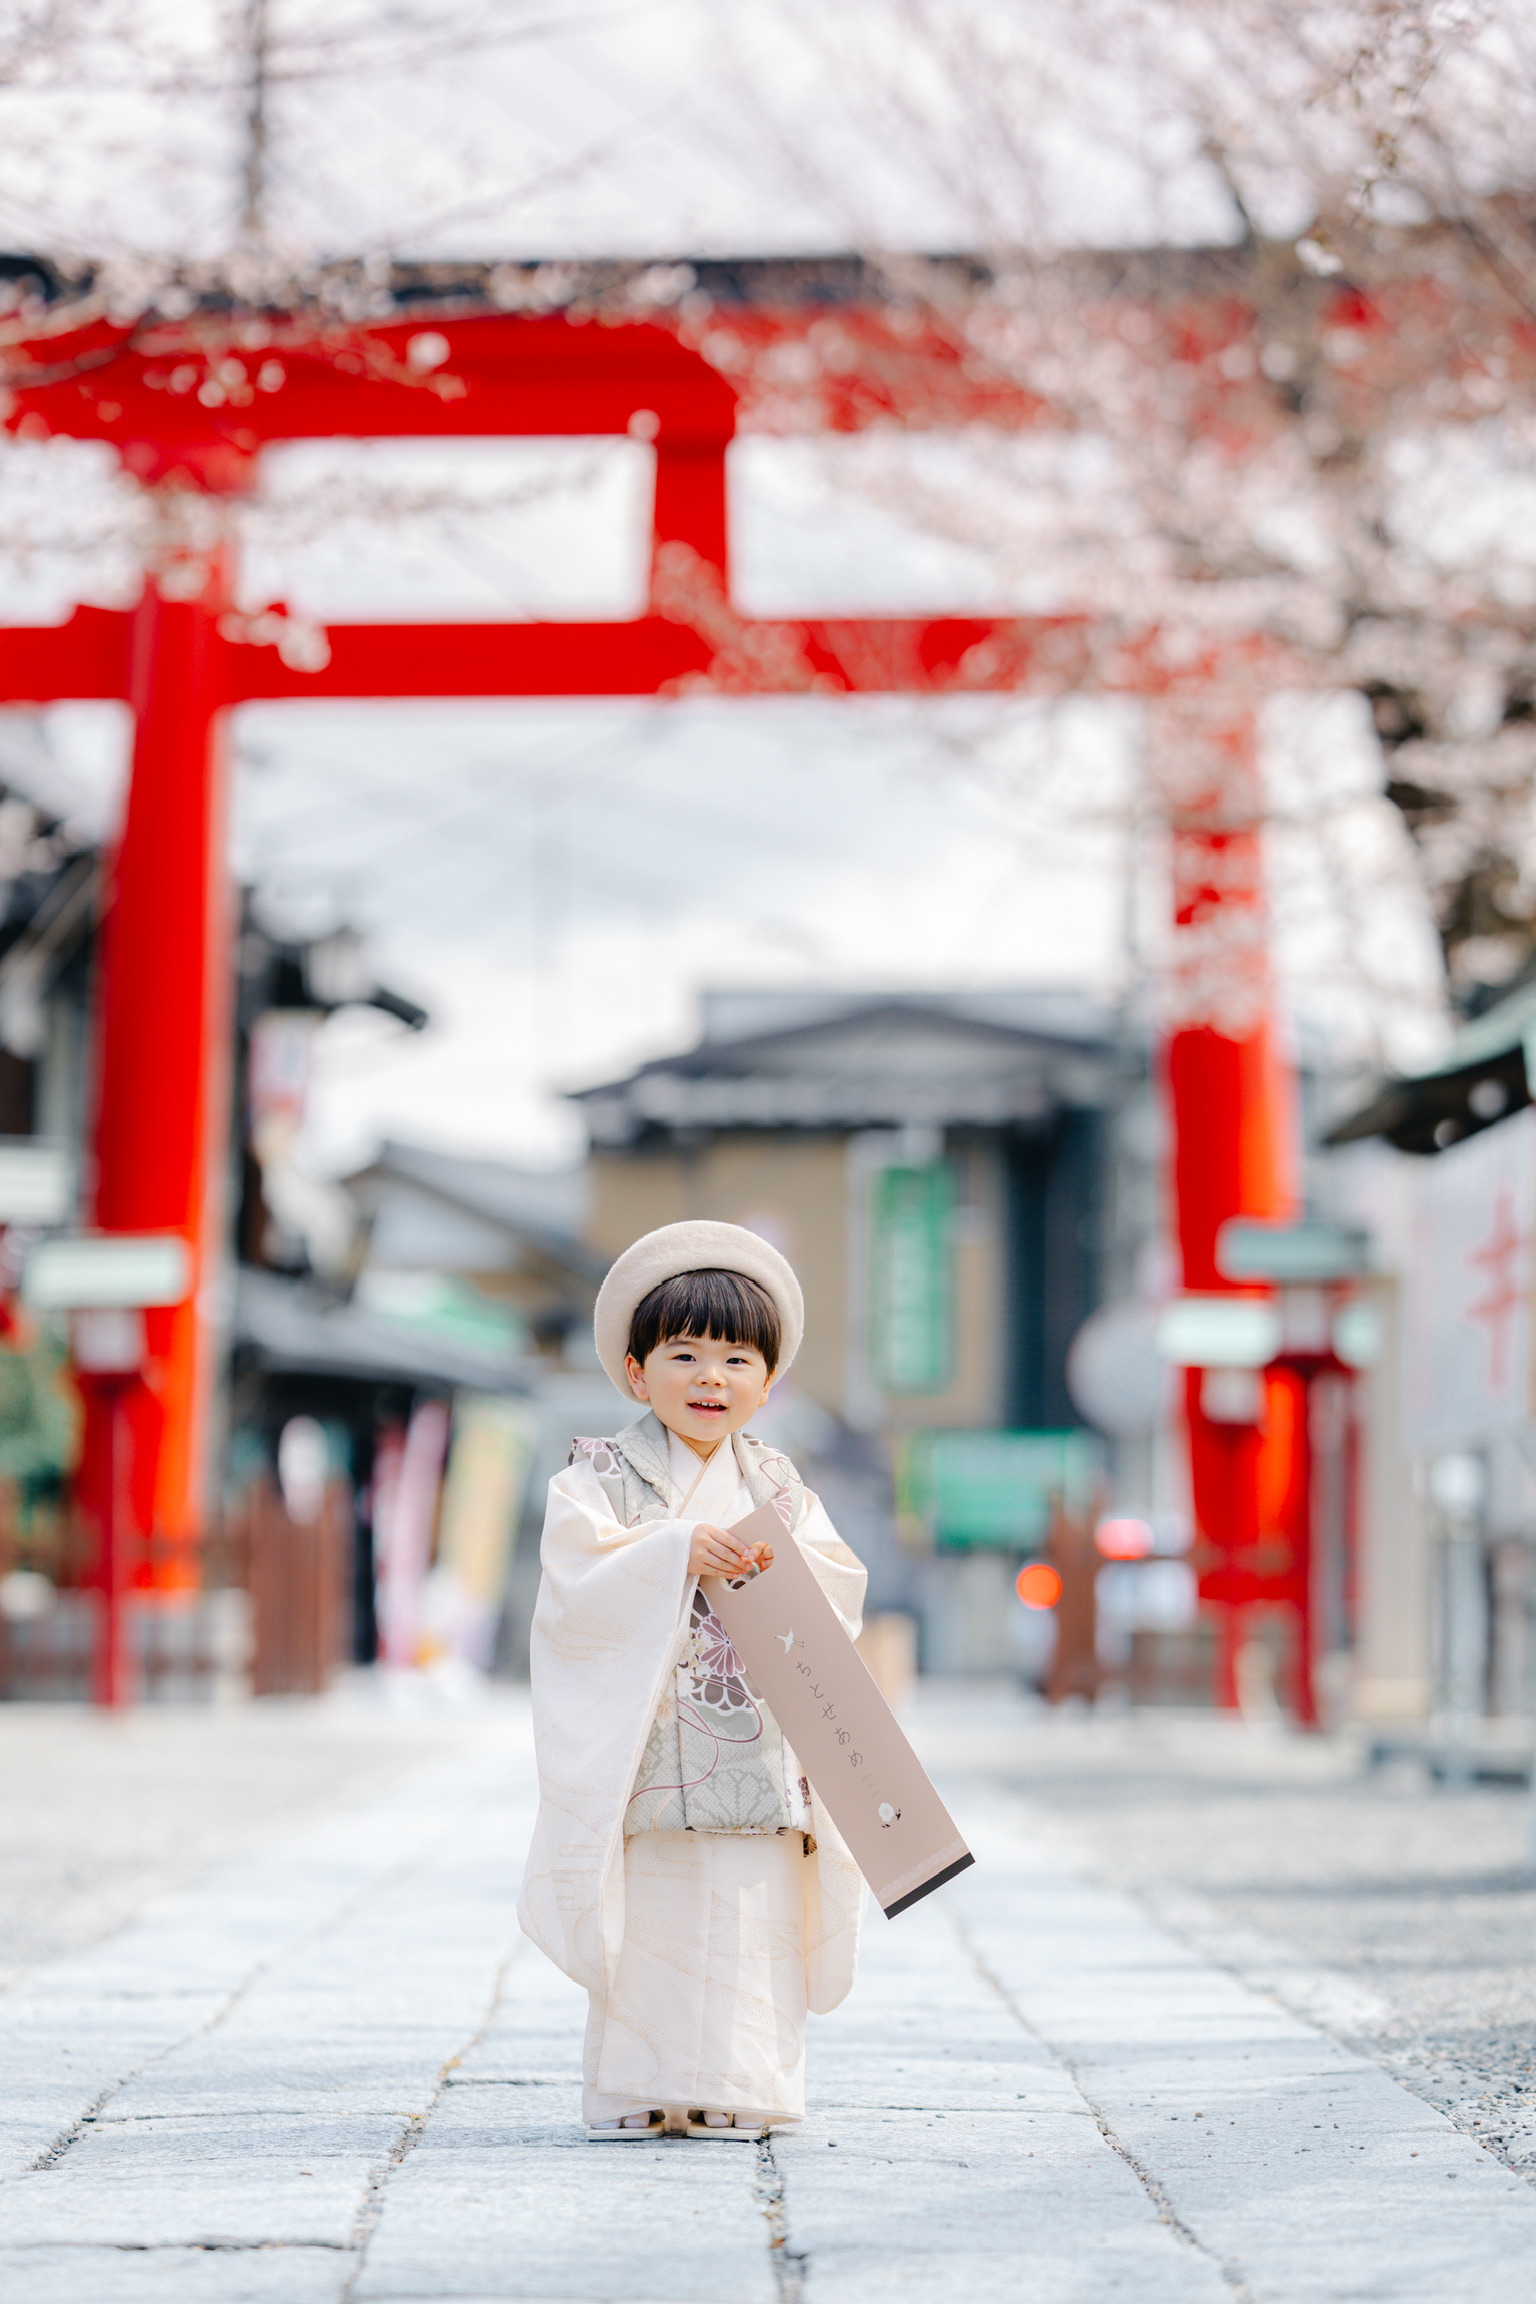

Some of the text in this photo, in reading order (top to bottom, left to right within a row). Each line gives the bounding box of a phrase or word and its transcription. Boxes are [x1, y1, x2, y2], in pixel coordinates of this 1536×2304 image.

[796, 1661, 864, 1768] ちとせあめ
